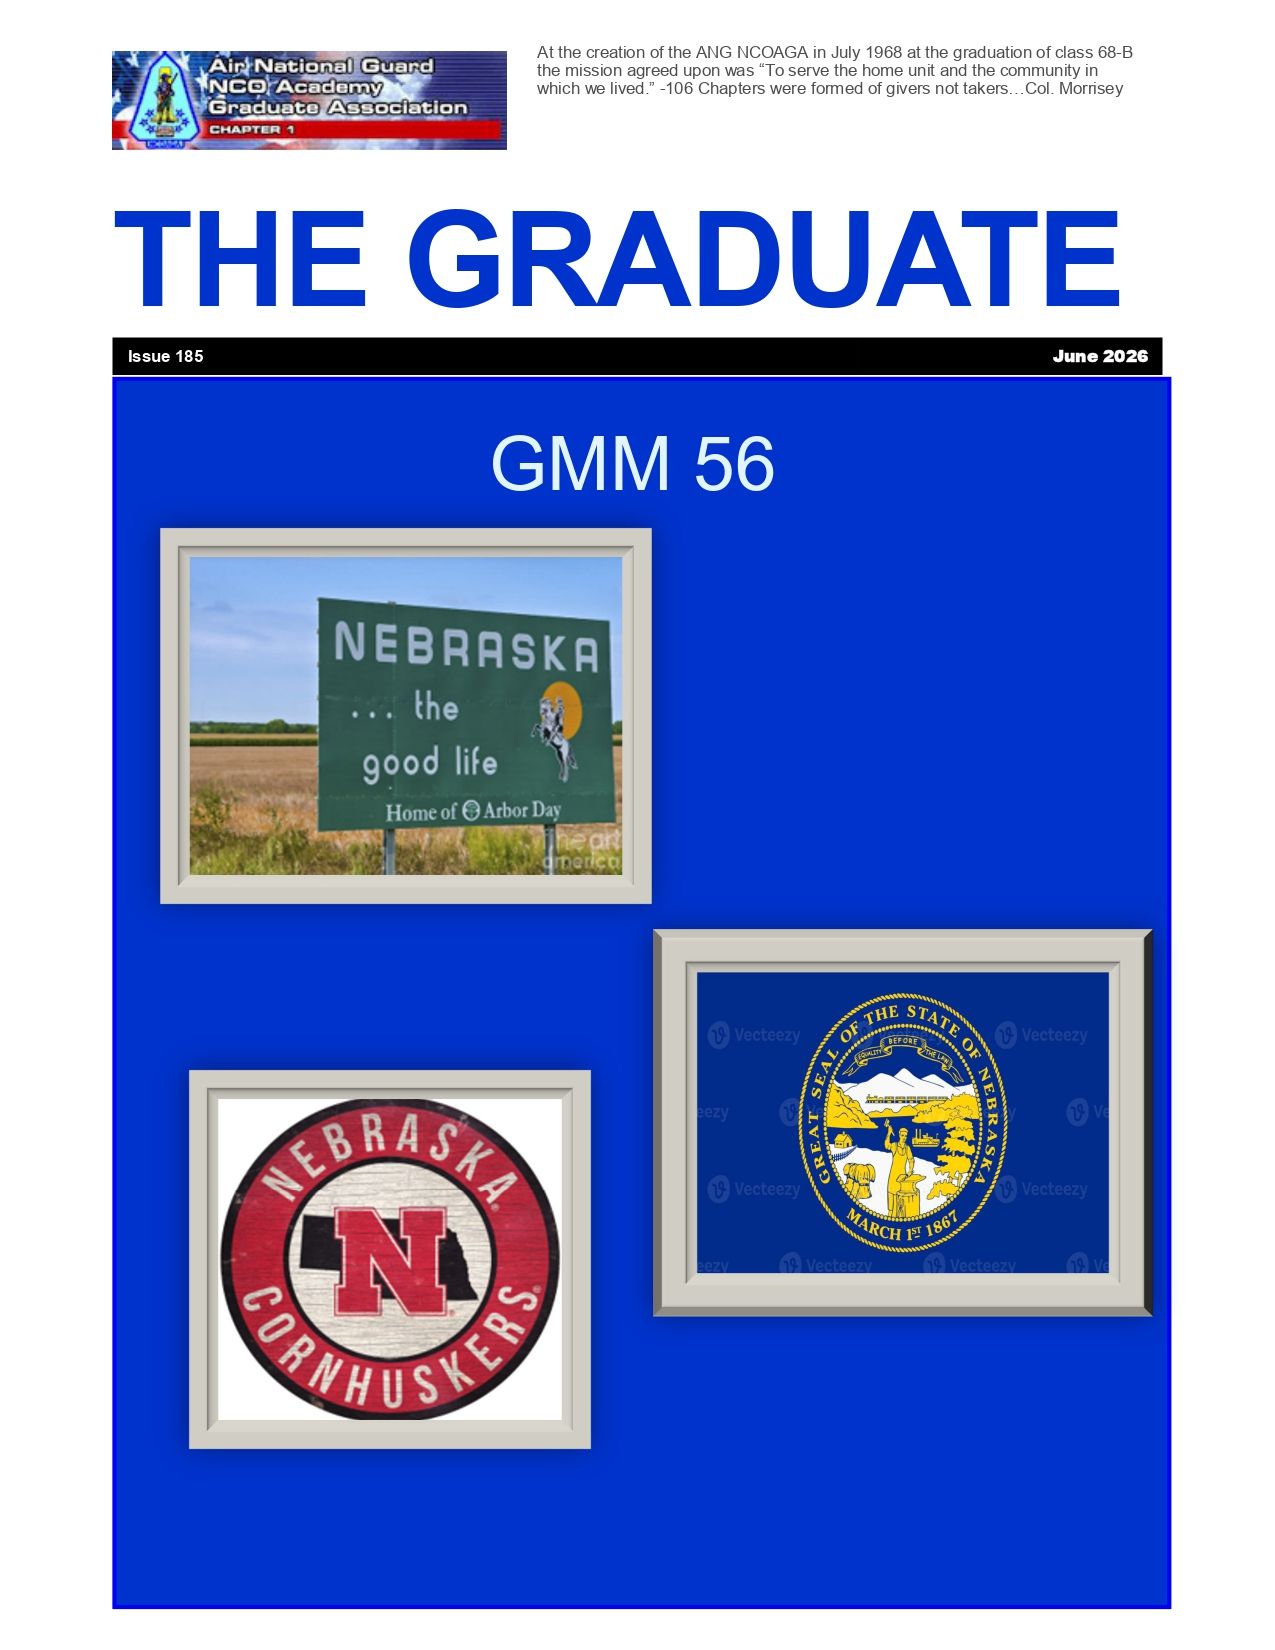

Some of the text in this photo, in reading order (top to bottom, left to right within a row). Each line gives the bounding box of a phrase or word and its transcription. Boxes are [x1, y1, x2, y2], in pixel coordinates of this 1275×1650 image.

[537, 46, 1133, 61] At the creation of the ANG NCOAGA in July 1968 at the graduation of class 68-B
[208, 57, 434, 74] Air National Guard
[537, 63, 1098, 79] the mission agreed upon was “To serve the home unit and the community in
[208, 78, 384, 97] NCO Academy
[537, 82, 580, 94] which
[585, 85, 605, 94] we
[611, 82, 654, 94] lived.”
[660, 82, 693, 94] -106
[699, 82, 765, 97] Chapters
[770, 85, 806, 94] were
[811, 82, 862, 94] formed
[868, 82, 882, 94] of
[886, 82, 930, 97] givers
[936, 82, 959, 94] not
[1060, 82, 1123, 97] Morrisey
[208, 99, 468, 115] Graduate Association
[209, 125, 295, 135] CHAPTER 1
[115, 209, 1119, 308] THE GRADUATE
[128, 350, 204, 363] Issue 185
[1053, 350, 1149, 363] June 2026
[492, 435, 774, 492] GMM 56
[335, 620, 598, 673] NEBRASKA
[414, 689, 460, 721] the
[363, 745, 498, 785] good life
[386, 800, 561, 822] Home of Arbor Day
[864, 1004, 899, 1026] THE
[907, 1005, 961, 1038] STATE
[840, 1021, 860, 1044] OF
[888, 1037, 918, 1046] BEFORE
[961, 1038, 982, 1060] OF
[811, 1049, 840, 1100] SEAL
[974, 1066, 998, 1185] NEBRASKA
[261, 1112, 519, 1204] NEBRASKA
[808, 1111, 831, 1185] GREAT
[846, 1207, 901, 1241] MARCH
[926, 1209, 958, 1237] 1867
[333, 1206, 448, 1318] N
[242, 1285, 539, 1409] CORNHUSKERS
